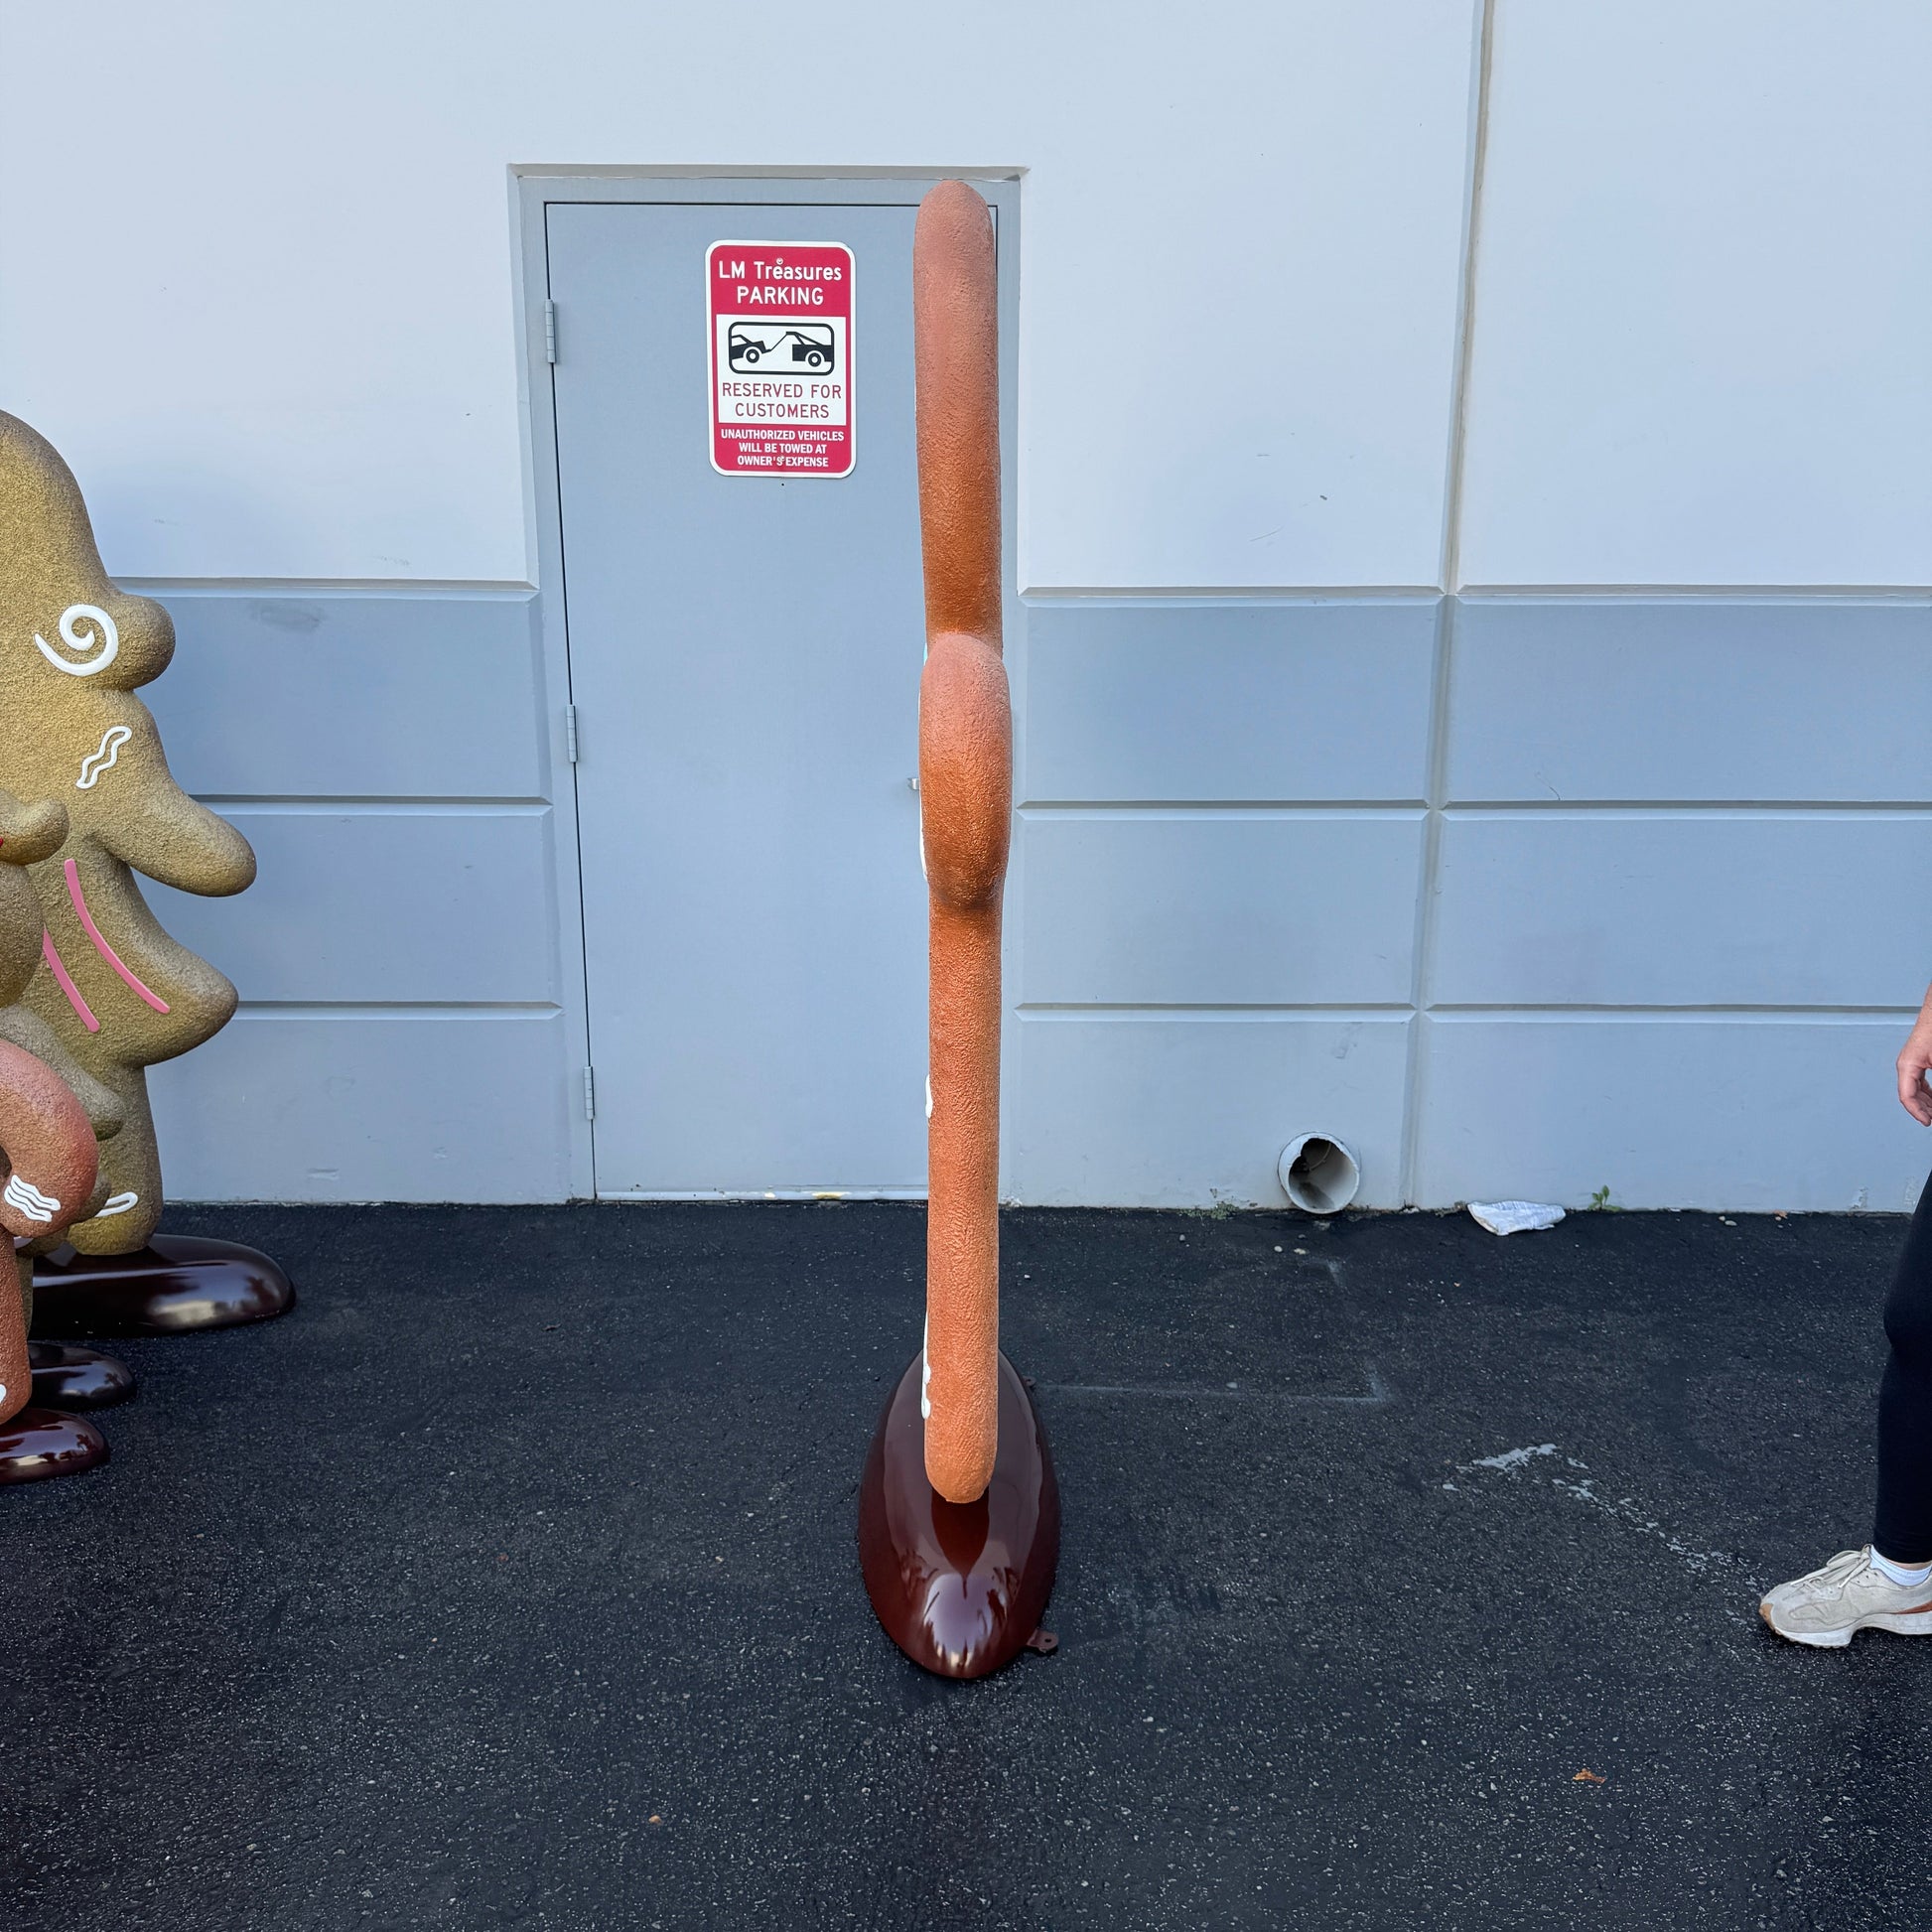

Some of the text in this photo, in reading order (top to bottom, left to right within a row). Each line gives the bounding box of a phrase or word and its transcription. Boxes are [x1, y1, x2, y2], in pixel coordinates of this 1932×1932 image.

[719, 260, 842, 281] LM Treasures
[737, 286, 824, 306] PARKING
[722, 382, 842, 399] RESERVED FOR
[735, 402, 829, 419] CUSTOMERS
[721, 428, 844, 442] UNAUTHORIZED VEHICLES
[739, 442, 827, 454] WILL BE TOWED AT
[785, 456, 829, 468] EXPENSE
